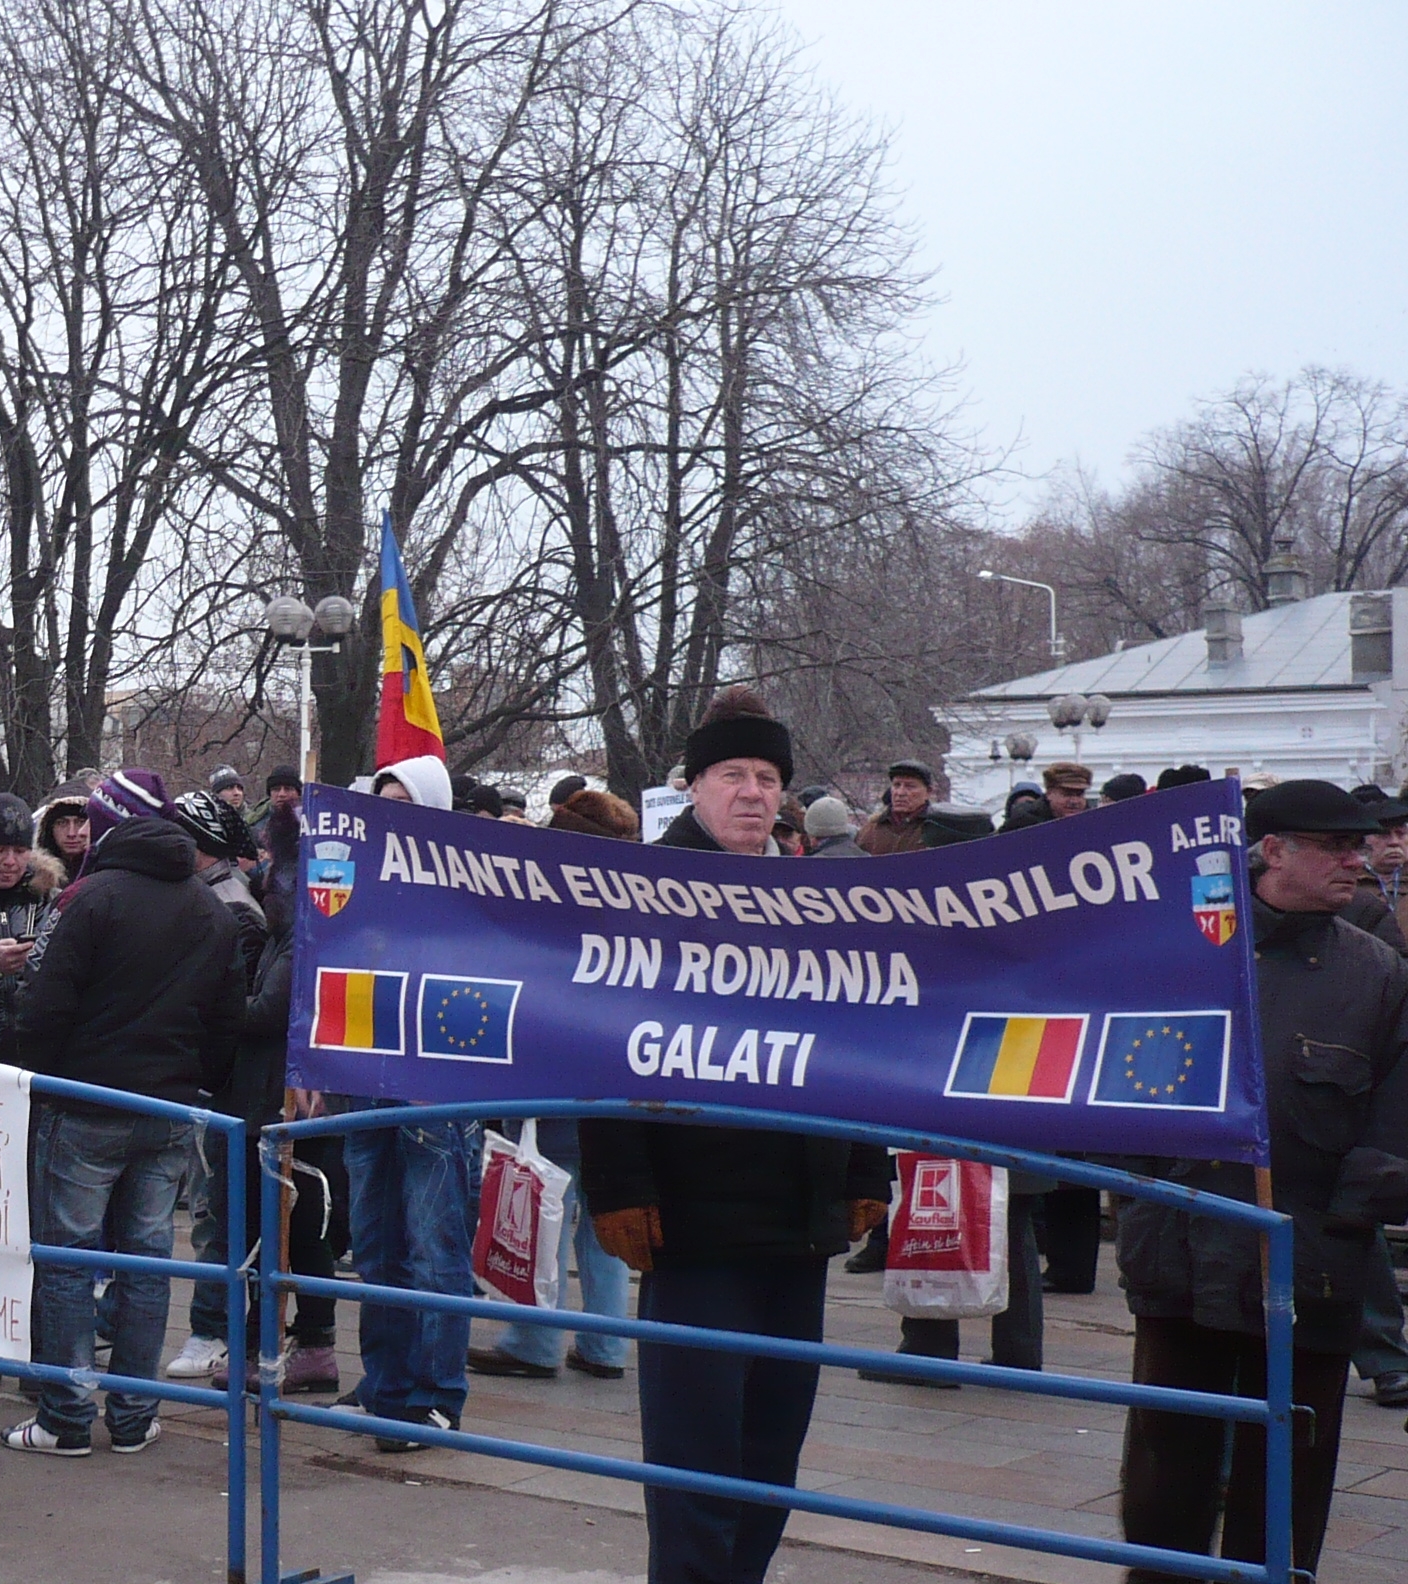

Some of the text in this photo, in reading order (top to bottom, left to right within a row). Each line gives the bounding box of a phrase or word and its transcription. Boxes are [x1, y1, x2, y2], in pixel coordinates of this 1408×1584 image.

[379, 832, 1161, 929] ALIANTA EUROPENSIONARILOR
[571, 933, 920, 1006] DIN ROMANIA
[626, 1020, 816, 1087] GALATI
